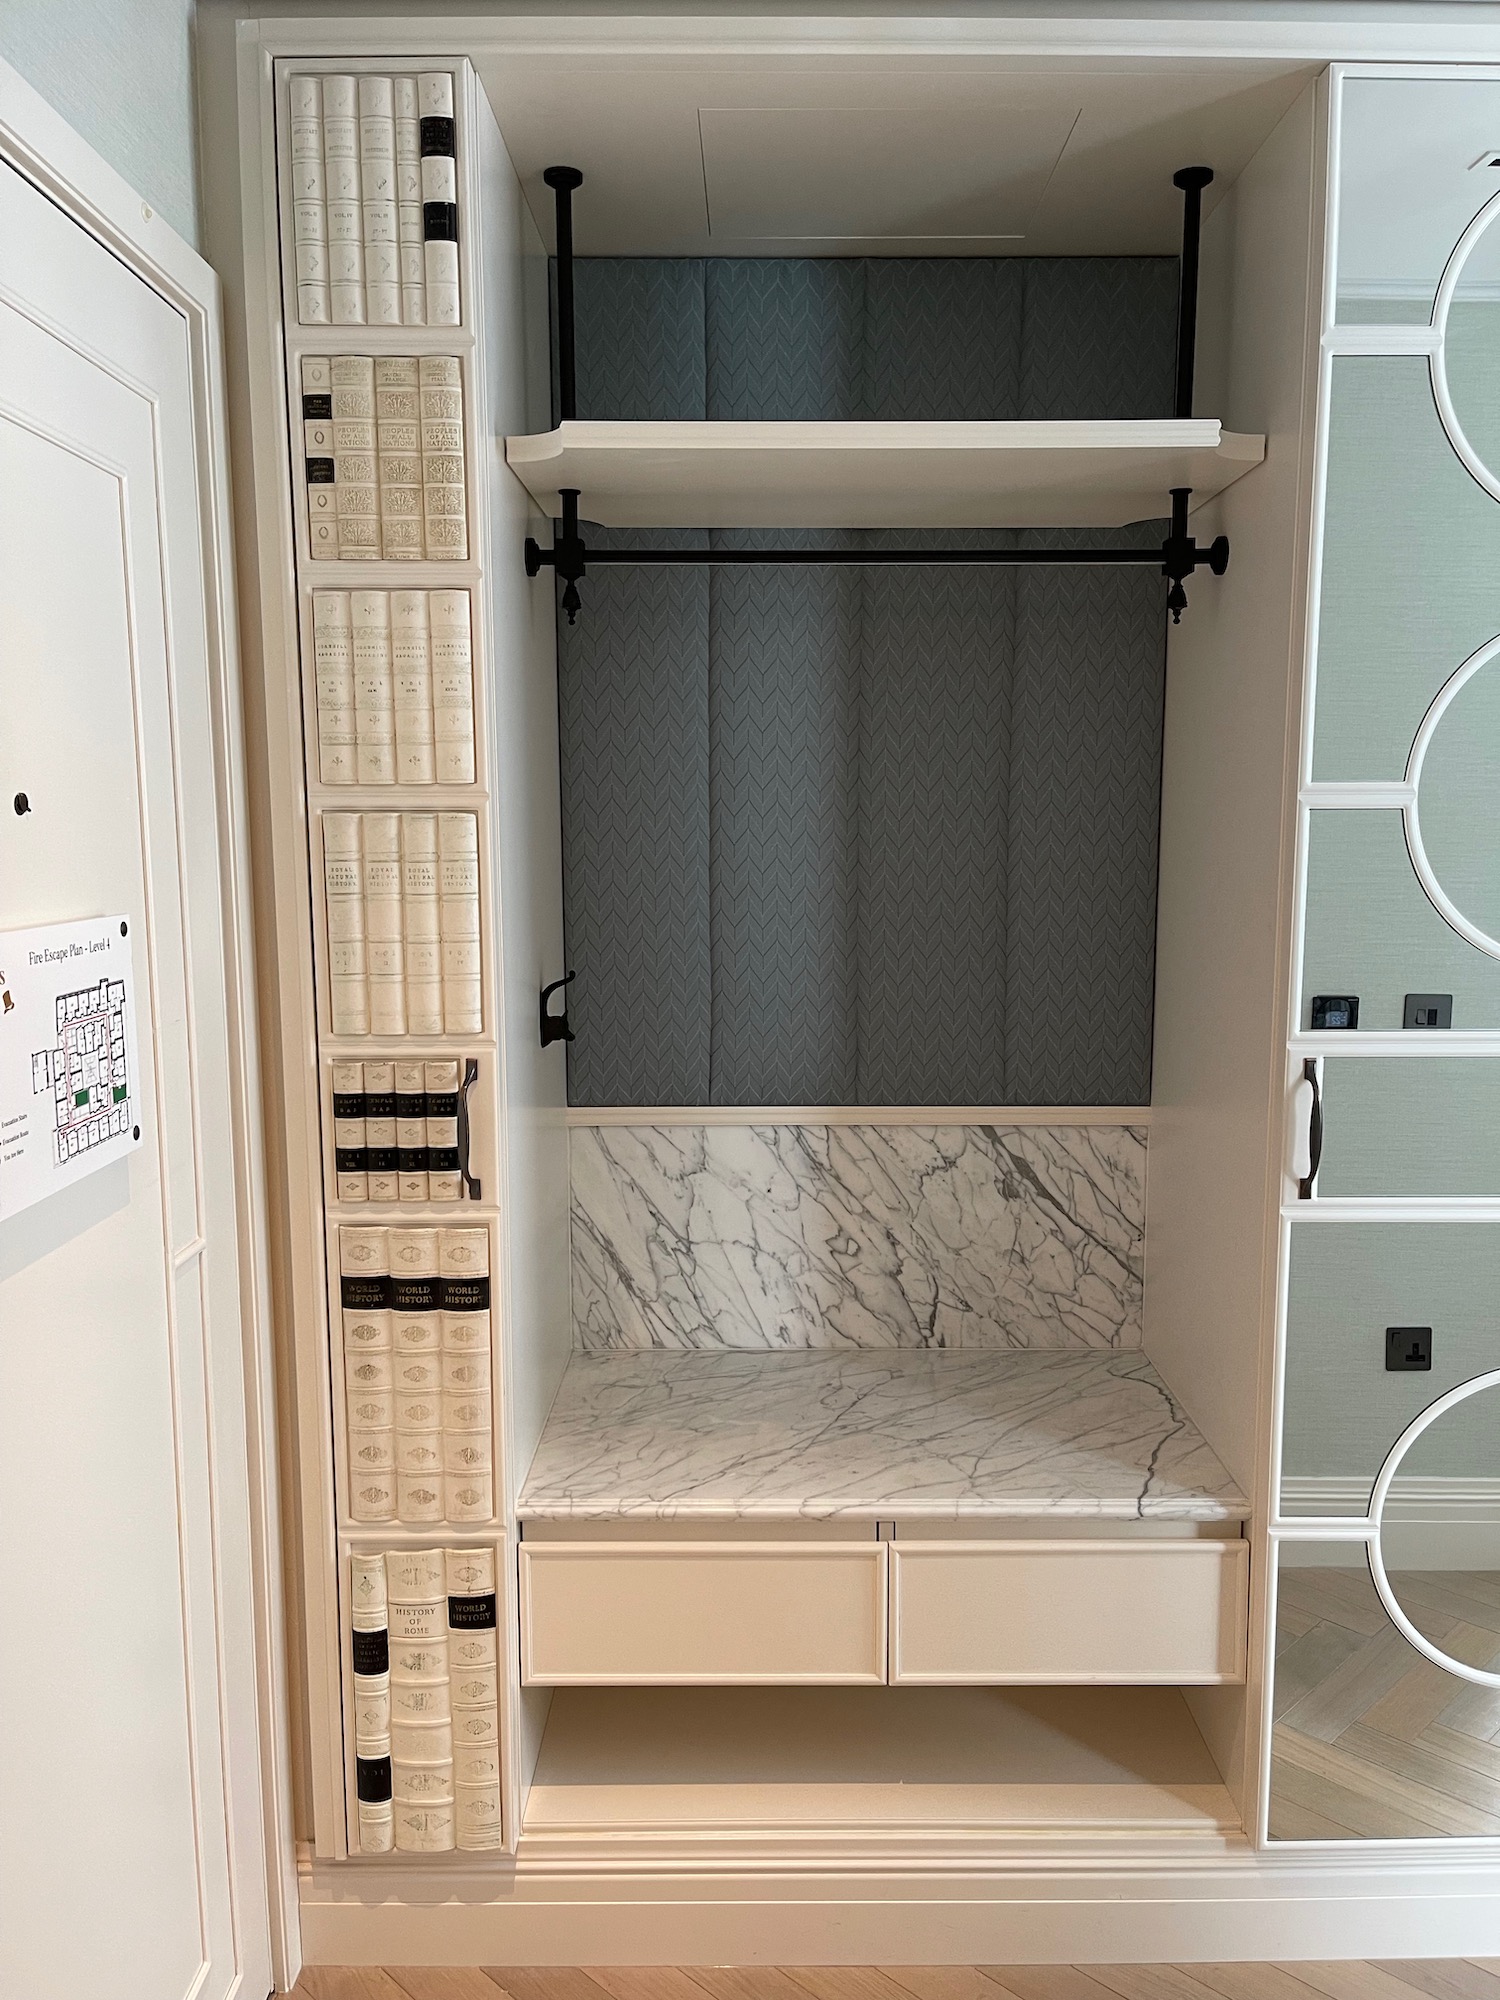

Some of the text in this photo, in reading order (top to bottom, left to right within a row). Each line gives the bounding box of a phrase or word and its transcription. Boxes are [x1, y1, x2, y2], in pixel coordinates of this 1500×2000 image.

[28, 951, 44, 965] Fire
[44, 948, 68, 964] Escape
[69, 943, 83, 957] Plan
[89, 937, 105, 953] Level
[349, 1285, 380, 1293] WORLD
[398, 1286, 431, 1294] WORLD
[448, 1286, 480, 1294] WORLD
[347, 1293, 385, 1302] HISTORY
[396, 1295, 434, 1304] HISTORY
[396, 1607, 436, 1616] HISTORY
[454, 1603, 487, 1612] WORLD
[453, 1612, 491, 1621] HISTORY
